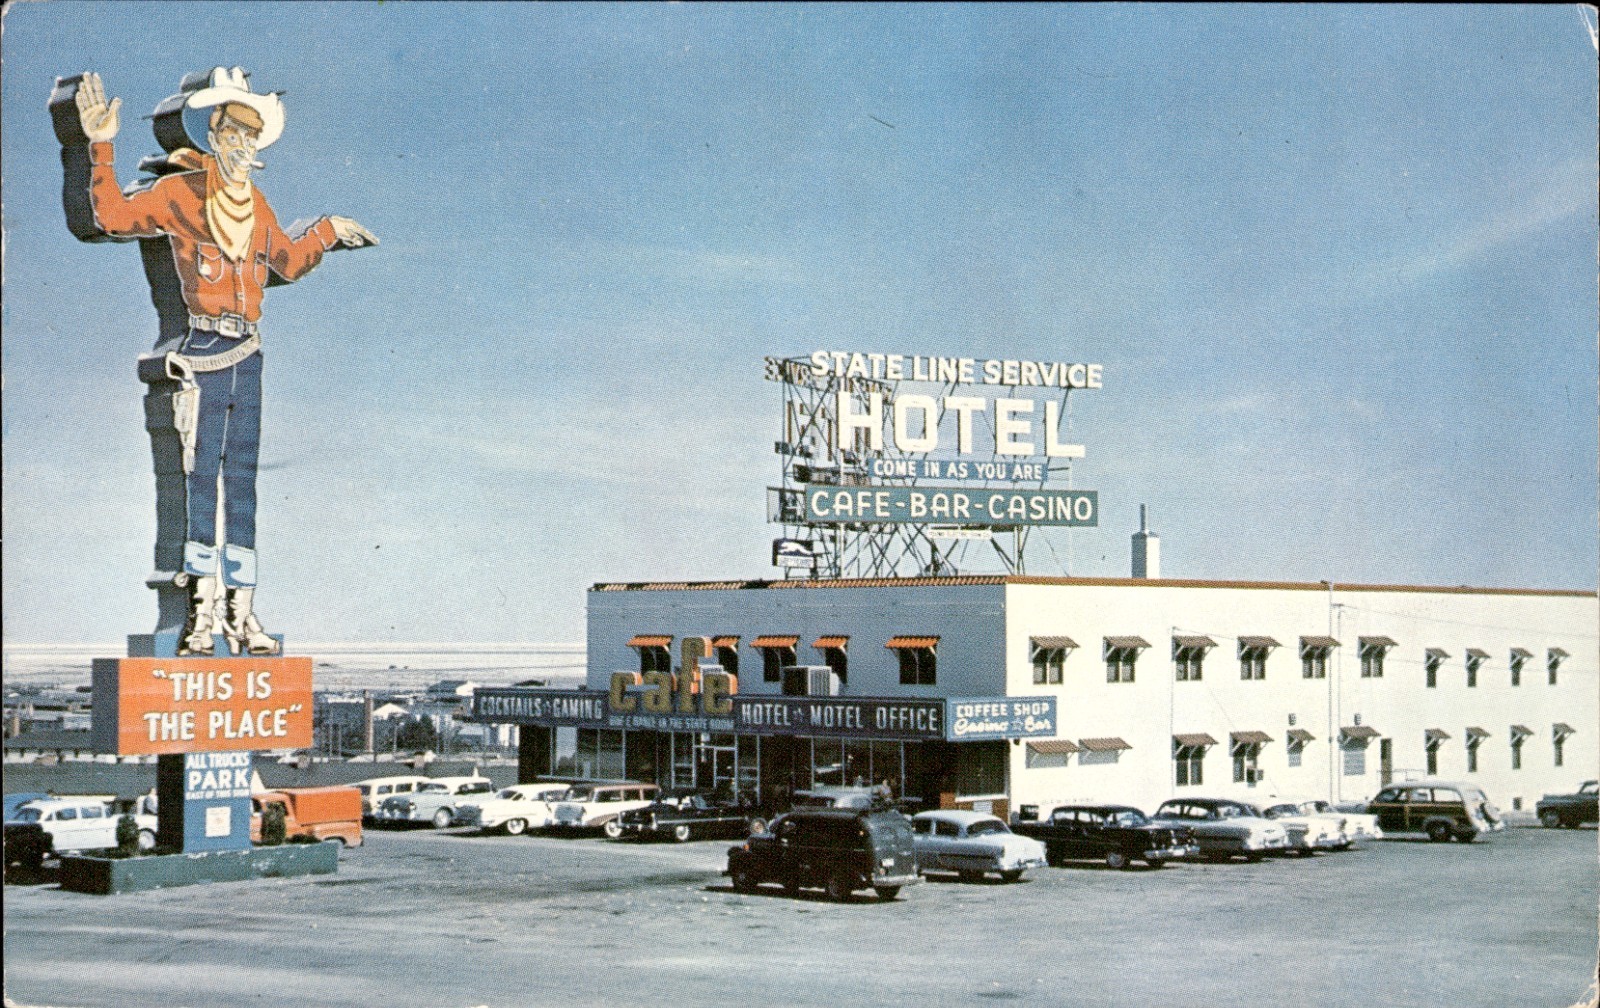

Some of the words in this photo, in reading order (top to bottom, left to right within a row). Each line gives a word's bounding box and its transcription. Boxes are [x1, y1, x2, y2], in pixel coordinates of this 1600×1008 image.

[811, 350, 904, 380] STATE
[913, 355, 975, 383] LINE
[983, 359, 1103, 389] SERVICE
[837, 390, 1086, 459] HOTEL
[873, 460, 917, 476] COME
[925, 461, 940, 478] IN
[947, 463, 968, 479] AS
[975, 463, 1006, 480] YOU
[1012, 464, 1042, 480] ARE
[246, 671, 272, 699] IS
[609, 636, 738, 714] cafe
[480, 696, 542, 717] COCKTAILS
[552, 697, 602, 720] GAMING
[742, 703, 791, 726] HOTEL
[810, 704, 864, 729] MOTEL
[876, 706, 938, 731] OFFICE
[956, 703, 1008, 718] COFFEE
[1013, 702, 1049, 716] SHOP
[143, 710, 196, 742] THE
[954, 718, 1009, 735] Casino
[1024, 715, 1052, 732] Bar
[185, 753, 207, 769] ALL
[208, 751, 249, 769] TRUCKS
[188, 768, 249, 791] PARK
